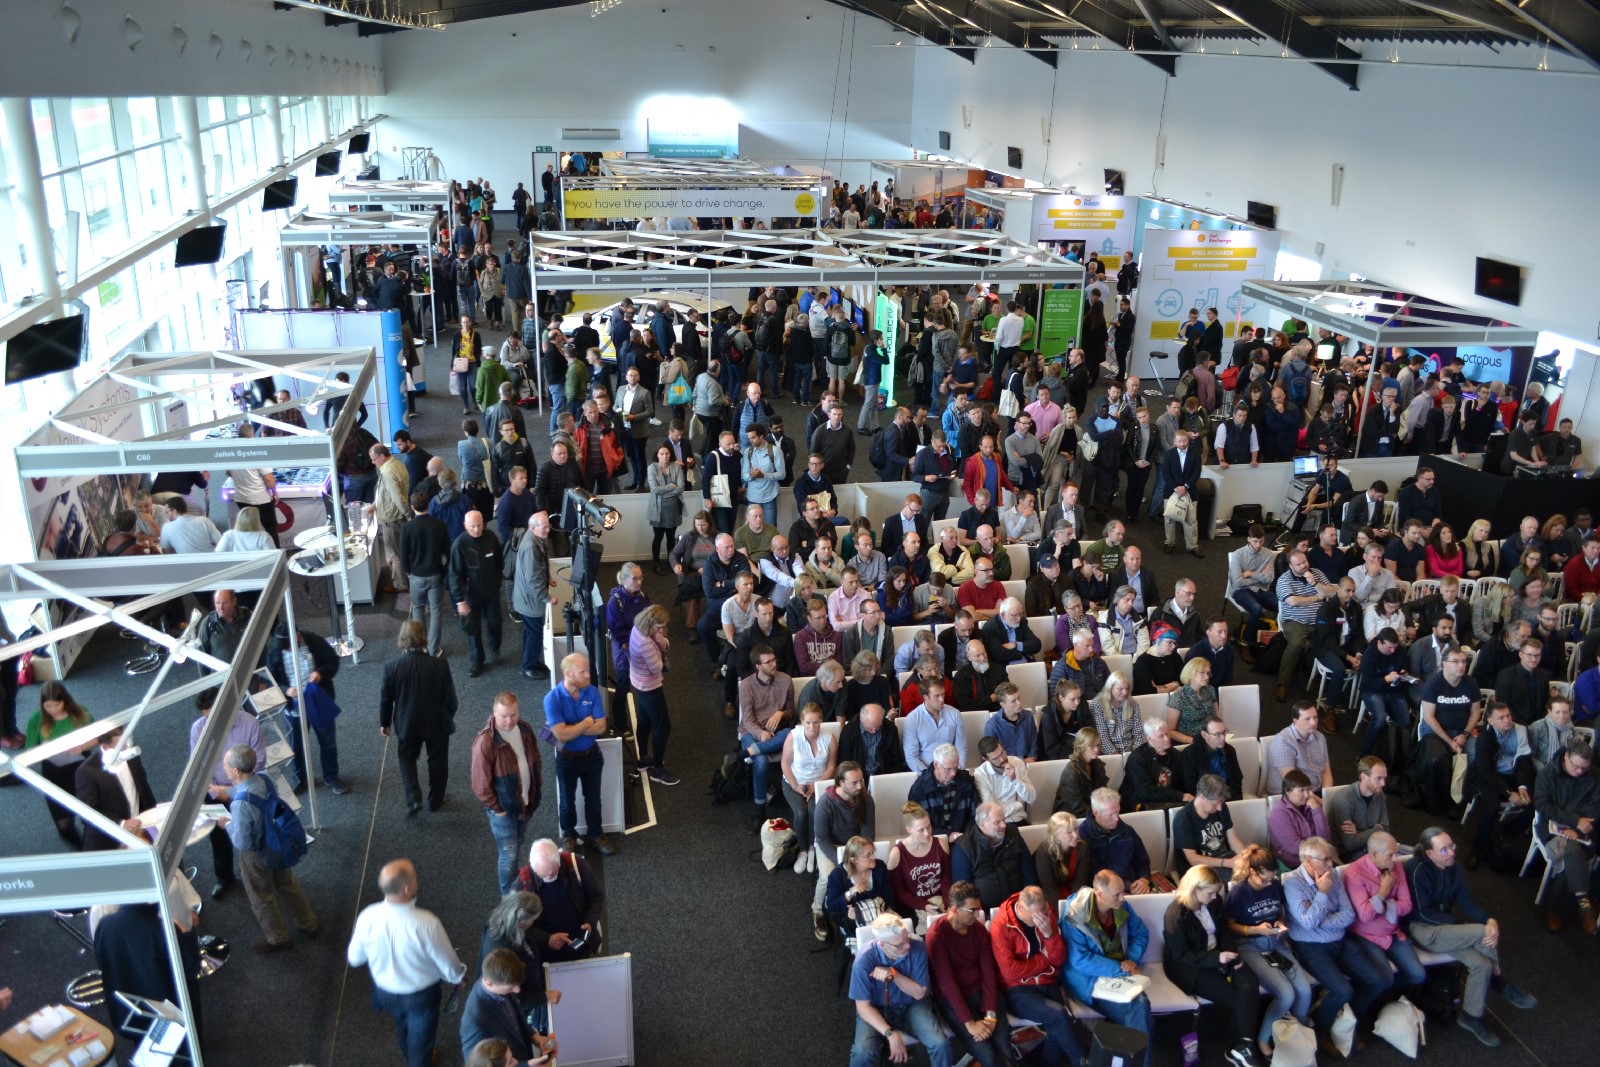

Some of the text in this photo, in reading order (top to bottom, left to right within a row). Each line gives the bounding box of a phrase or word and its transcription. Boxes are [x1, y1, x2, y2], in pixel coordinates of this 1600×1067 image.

[572, 199, 765, 210] you have the power to drive change.
[886, 320, 894, 354] ROLEC
[1462, 353, 1502, 368] octopus
[237, 449, 268, 457] Systems
[1247, 900, 1280, 913] COLORADO
